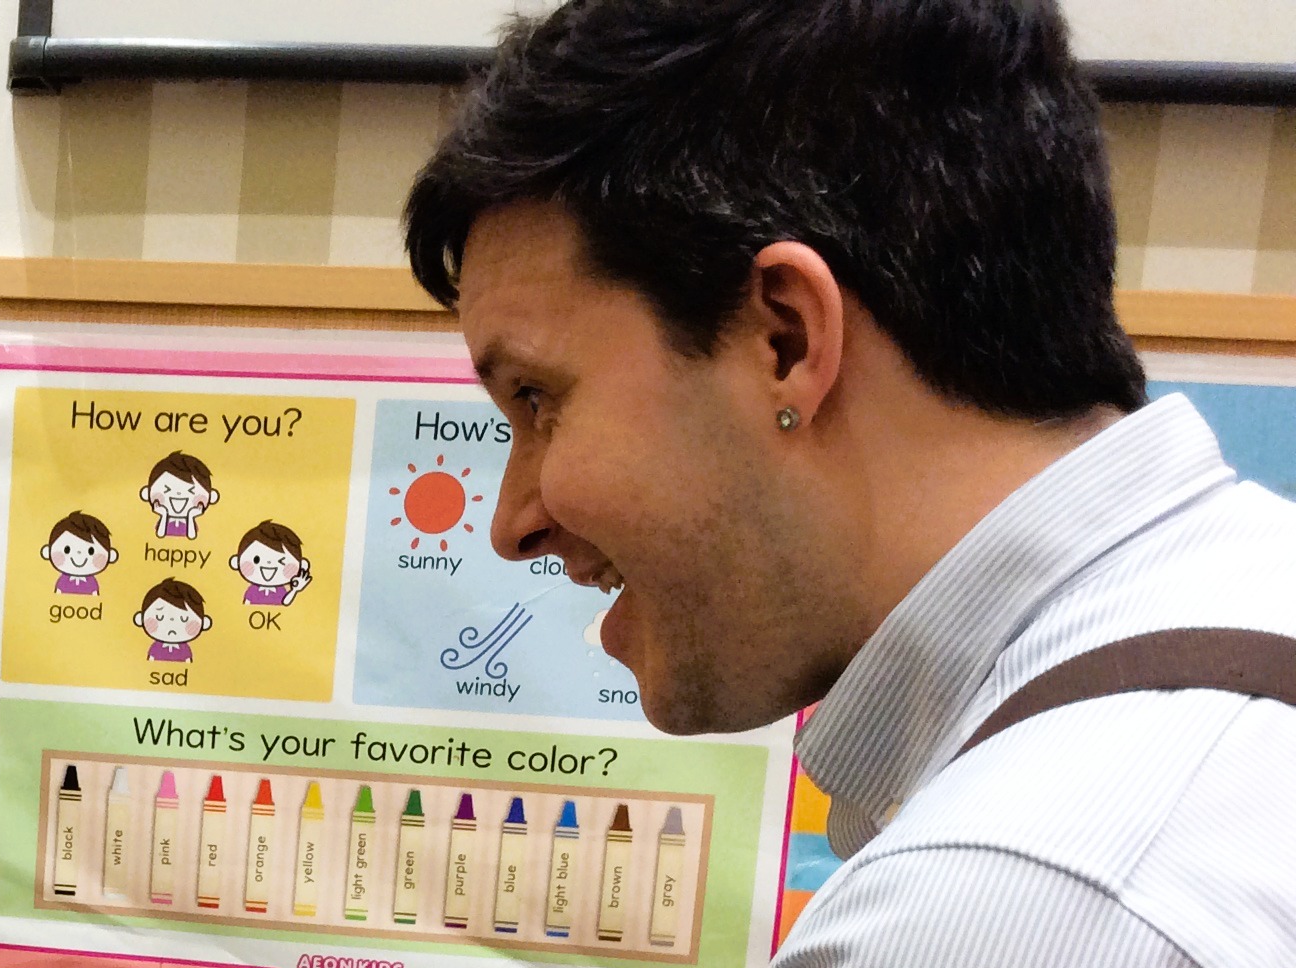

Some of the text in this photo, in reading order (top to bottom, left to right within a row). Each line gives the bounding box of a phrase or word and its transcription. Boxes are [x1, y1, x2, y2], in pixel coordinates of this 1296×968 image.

[70, 400, 302, 443] How are you?
[414, 411, 512, 444] How's
[144, 543, 211, 569] happy
[397, 554, 463, 576] sunny
[529, 556, 568, 576] clo
[49, 603, 103, 624] good
[248, 611, 281, 631] OK
[149, 668, 188, 686] sad
[456, 677, 521, 702] windy
[598, 688, 638, 705] sno
[133, 717, 618, 776] What's your favorite color?
[61, 826, 74, 861] black
[113, 829, 124, 866] white
[161, 837, 172, 866] pink
[208, 843, 217, 867] red
[254, 835, 267, 882] orange
[303, 841, 315, 884] yellow
[351, 833, 368, 900] light green
[404, 850, 415, 890] green
[454, 853, 467, 896] purple
[505, 865, 517, 893] blue
[553, 852, 570, 914] light blue
[610, 865, 623, 908] brown
[662, 874, 676, 907] gray
